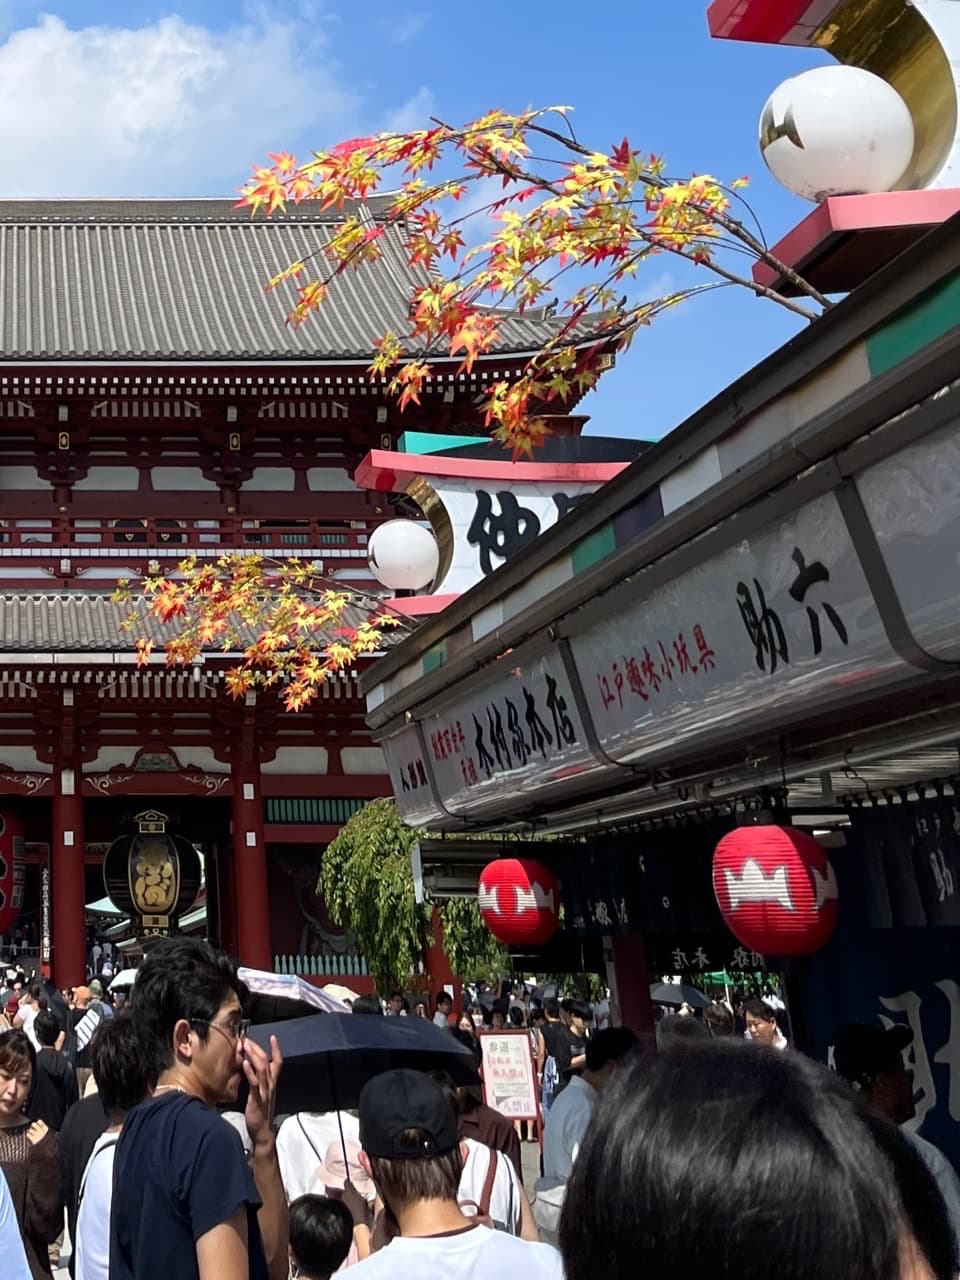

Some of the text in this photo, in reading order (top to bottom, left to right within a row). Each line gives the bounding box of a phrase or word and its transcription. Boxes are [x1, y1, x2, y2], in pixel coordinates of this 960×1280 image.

[467, 489, 593, 576] 仲
[736, 546, 848, 675] 助六
[597, 624, 715, 711] 江戸趣味小玩具
[472, 673, 577, 777] 木村家本店
